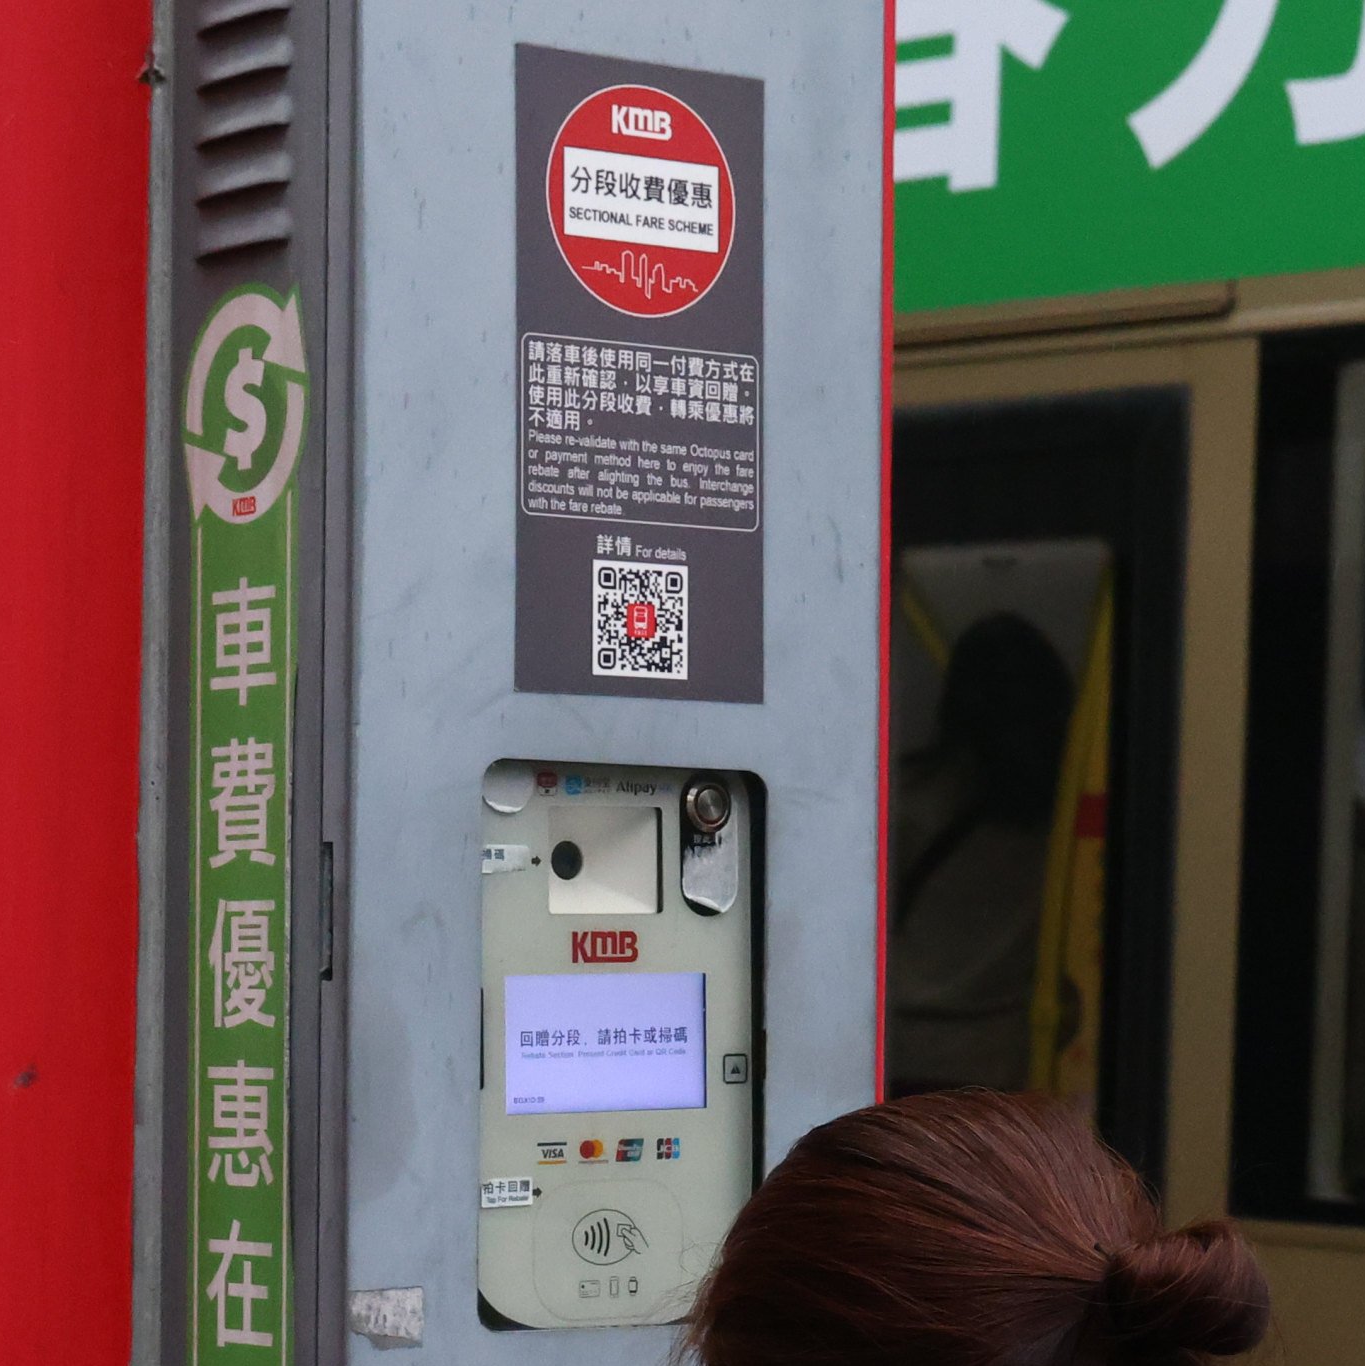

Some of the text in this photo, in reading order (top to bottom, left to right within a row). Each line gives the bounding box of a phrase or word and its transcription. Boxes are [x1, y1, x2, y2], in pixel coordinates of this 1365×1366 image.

[611, 104, 673, 142] KMB
[570, 165, 713, 209] 分段收費優惠
[569, 206, 714, 237] SECTIONAL FARE SCHEME
[528, 341, 754, 382] 請落車後使用同一付費方式在
[528, 429, 754, 462] Please re-validate with the same Octopus card
[528, 449, 754, 478] or payment method here to enjoy the fare
[528, 463, 560, 478] rebate
[567, 466, 590, 479] after
[597, 469, 639, 487] alighting
[646, 473, 663, 486] the
[699, 477, 754, 496] Interchange
[528, 480, 754, 512] discounts will not be applicable for passengers
[528, 497, 548, 510] with
[550, 497, 566, 511] the
[568, 499, 588, 513] fare
[596, 534, 687, 561] 詳情 For details
[571, 930, 639, 964] KMB
[542, 1149, 565, 1159] VISA
